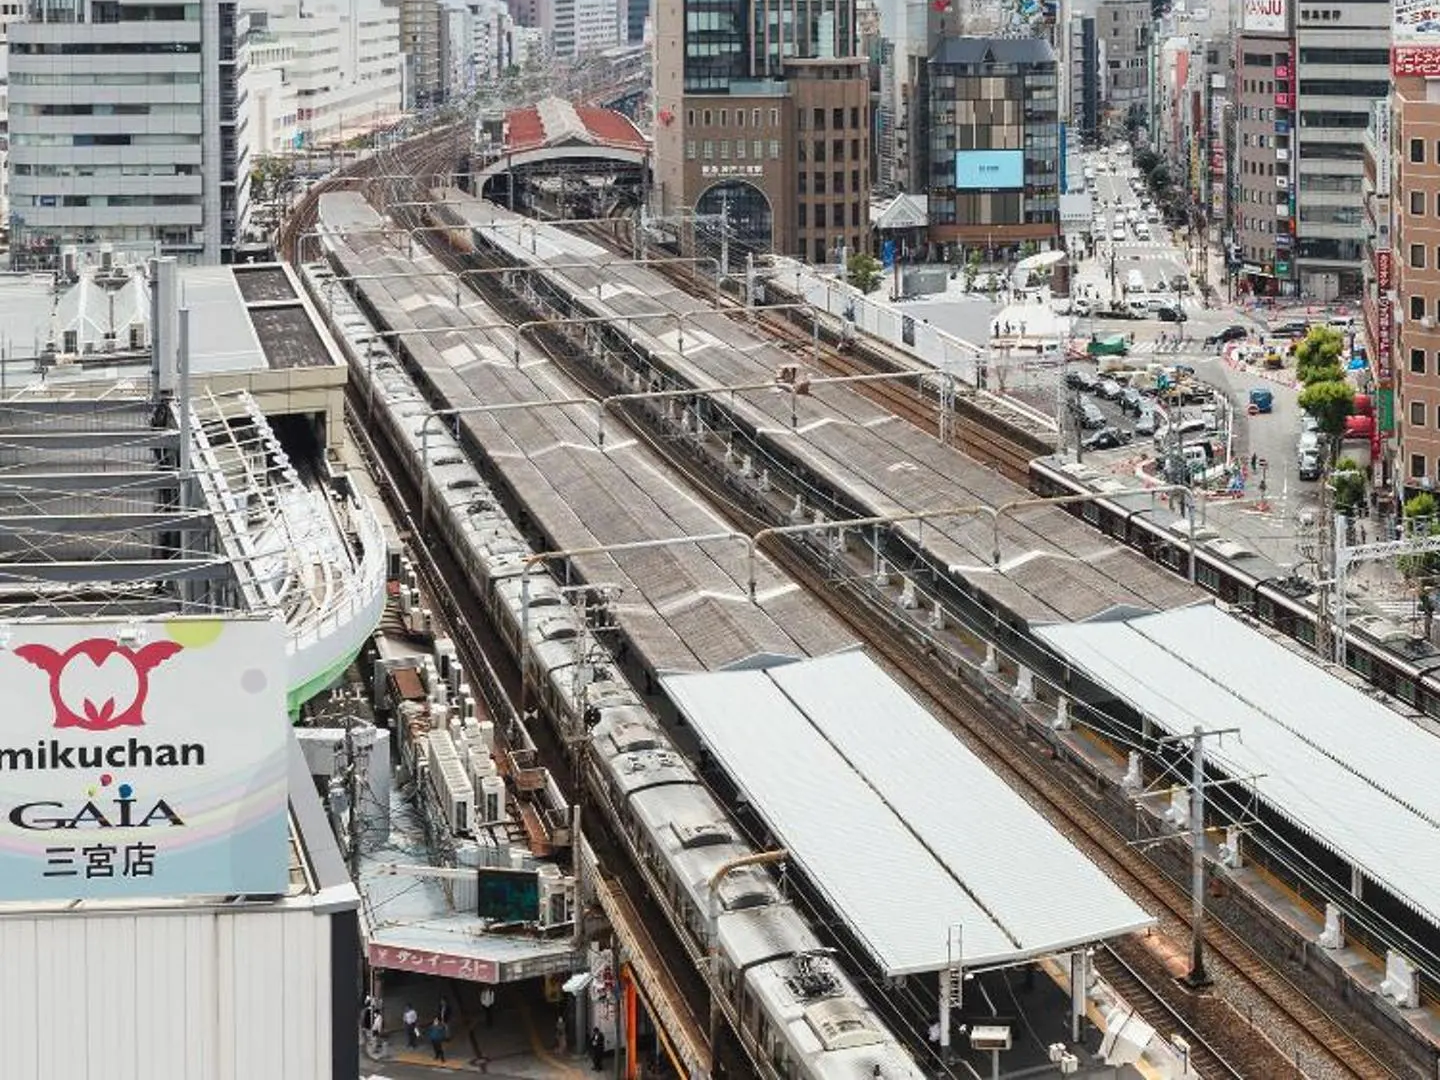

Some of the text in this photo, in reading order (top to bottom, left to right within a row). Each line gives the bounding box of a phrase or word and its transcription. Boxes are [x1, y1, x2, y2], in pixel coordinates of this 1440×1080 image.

[0, 738, 205, 770] mikuchan
[43, 842, 157, 879] 三宮店
